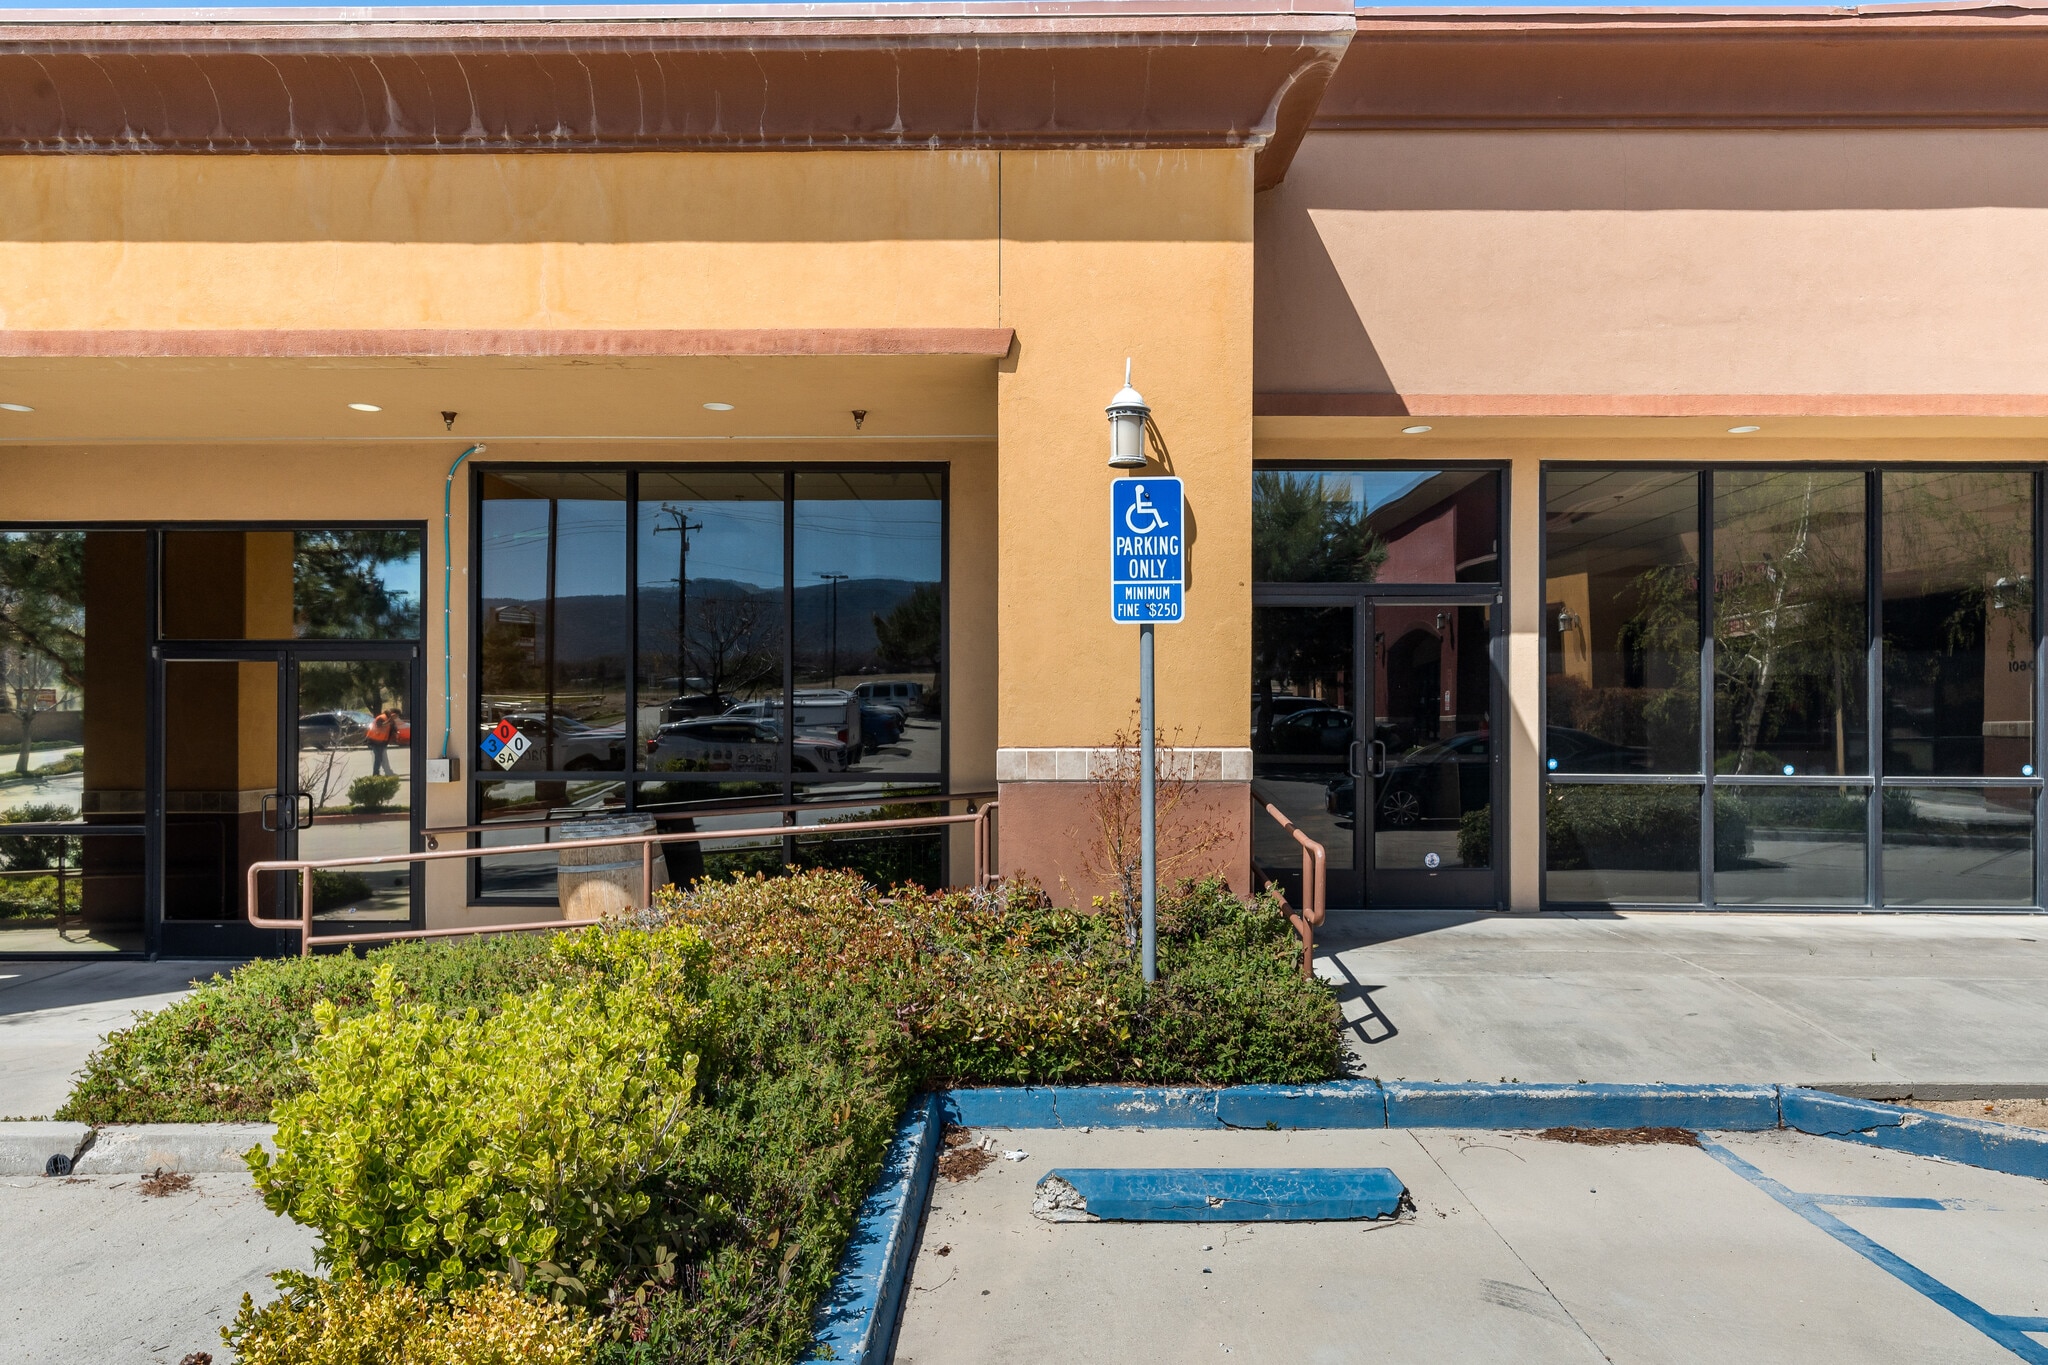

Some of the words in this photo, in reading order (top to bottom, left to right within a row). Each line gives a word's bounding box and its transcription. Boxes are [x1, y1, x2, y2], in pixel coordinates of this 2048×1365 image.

[1116, 535, 1179, 556] PARKING
[1128, 558, 1168, 579] ONLY
[1125, 586, 1170, 600] MINIMUM
[1118, 603, 1140, 617] FINE
[1148, 602, 1178, 618] $250
[500, 725, 510, 739] 0
[488, 739, 498, 753] 3
[514, 737, 523, 751] 0
[498, 753, 515, 764] SA
